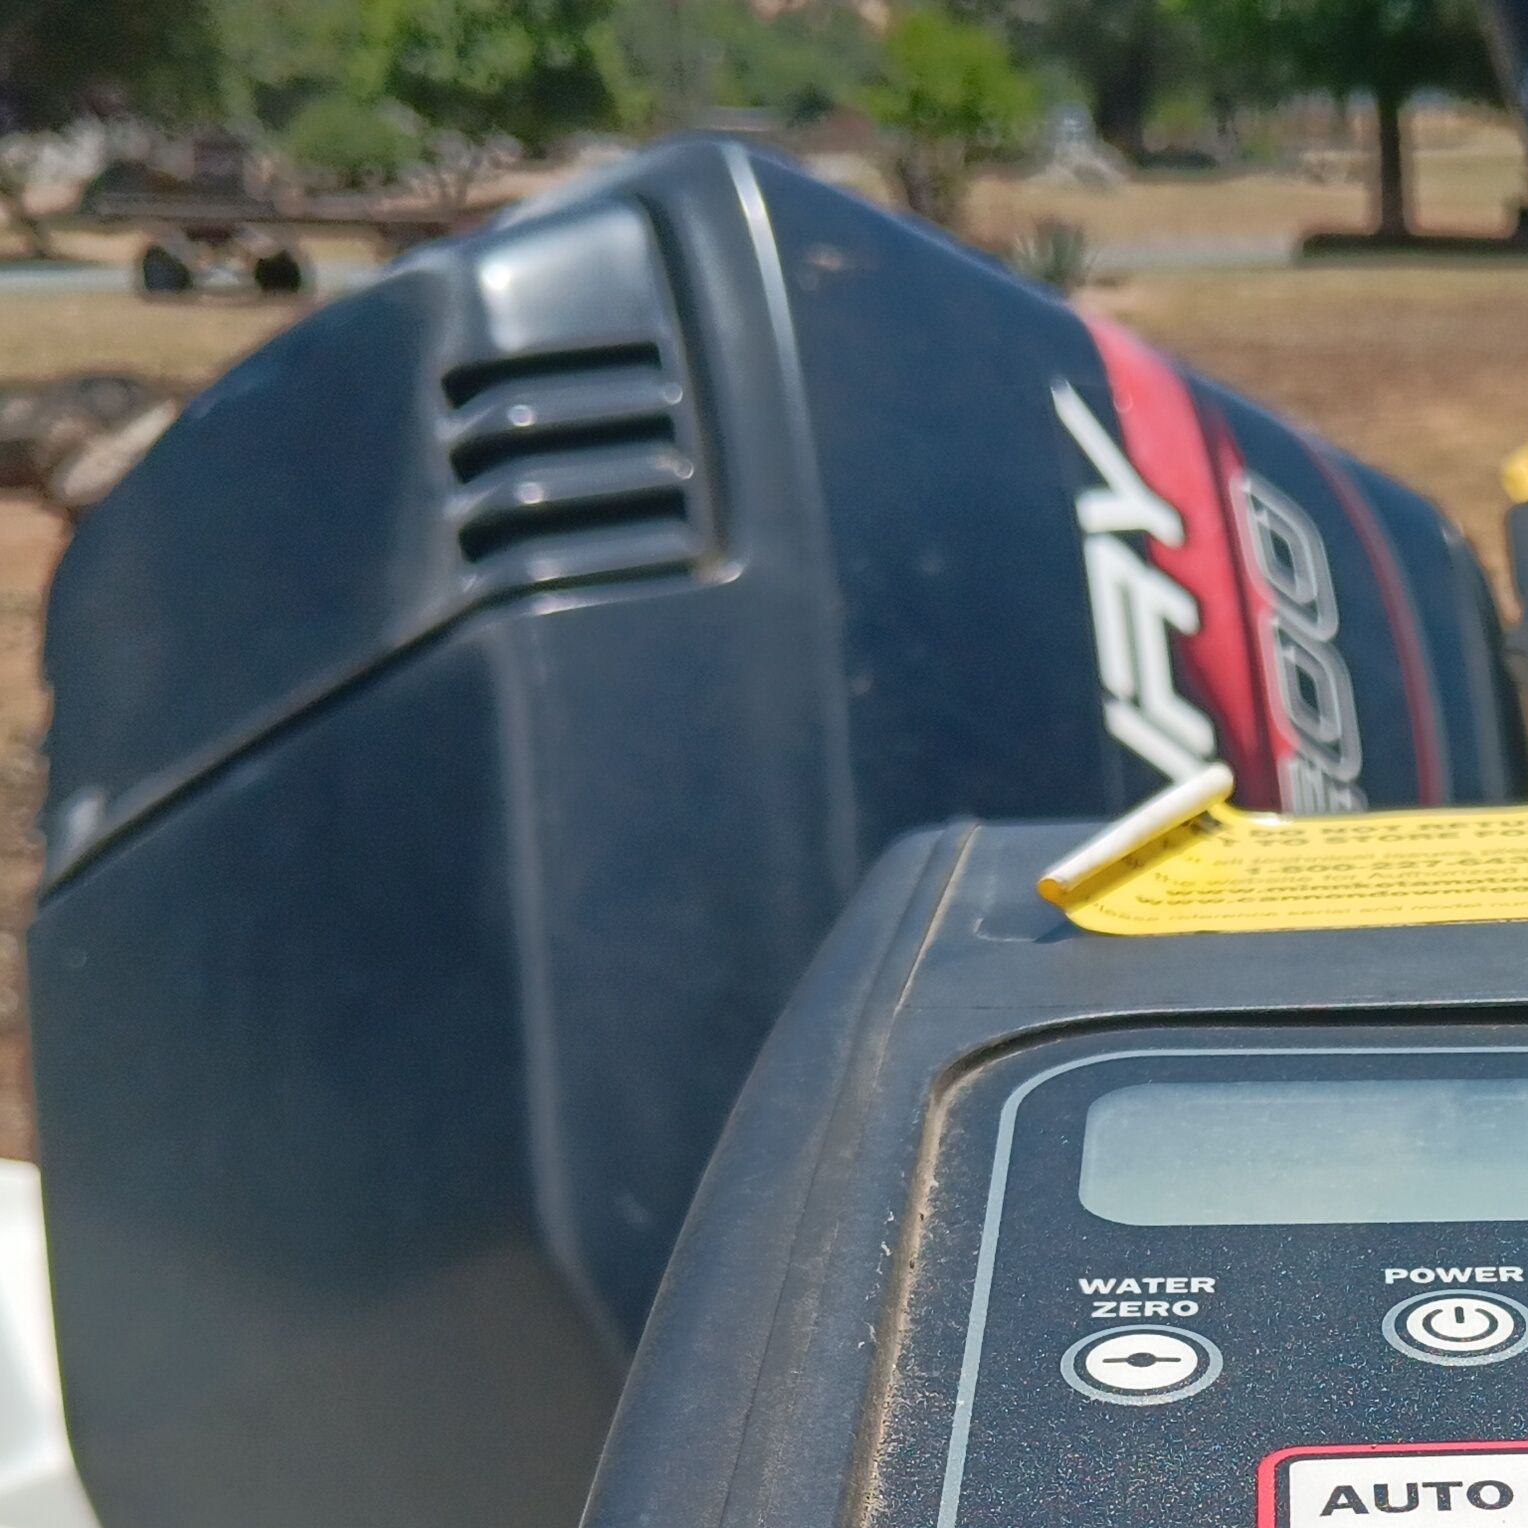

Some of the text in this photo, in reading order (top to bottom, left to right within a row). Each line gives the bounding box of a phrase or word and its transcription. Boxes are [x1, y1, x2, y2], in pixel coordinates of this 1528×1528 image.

[1249, 829, 1305, 837] DO
[1321, 825, 1401, 835] NOT
[1253, 838, 1309, 847] TO
[1324, 832, 1461, 845] STORE
[1384, 1265, 1525, 1285] POWER
[1078, 1275, 1216, 1296] WATER
[1091, 1299, 1200, 1319] ZERO
[1319, 1478, 1516, 1518] AUTO
